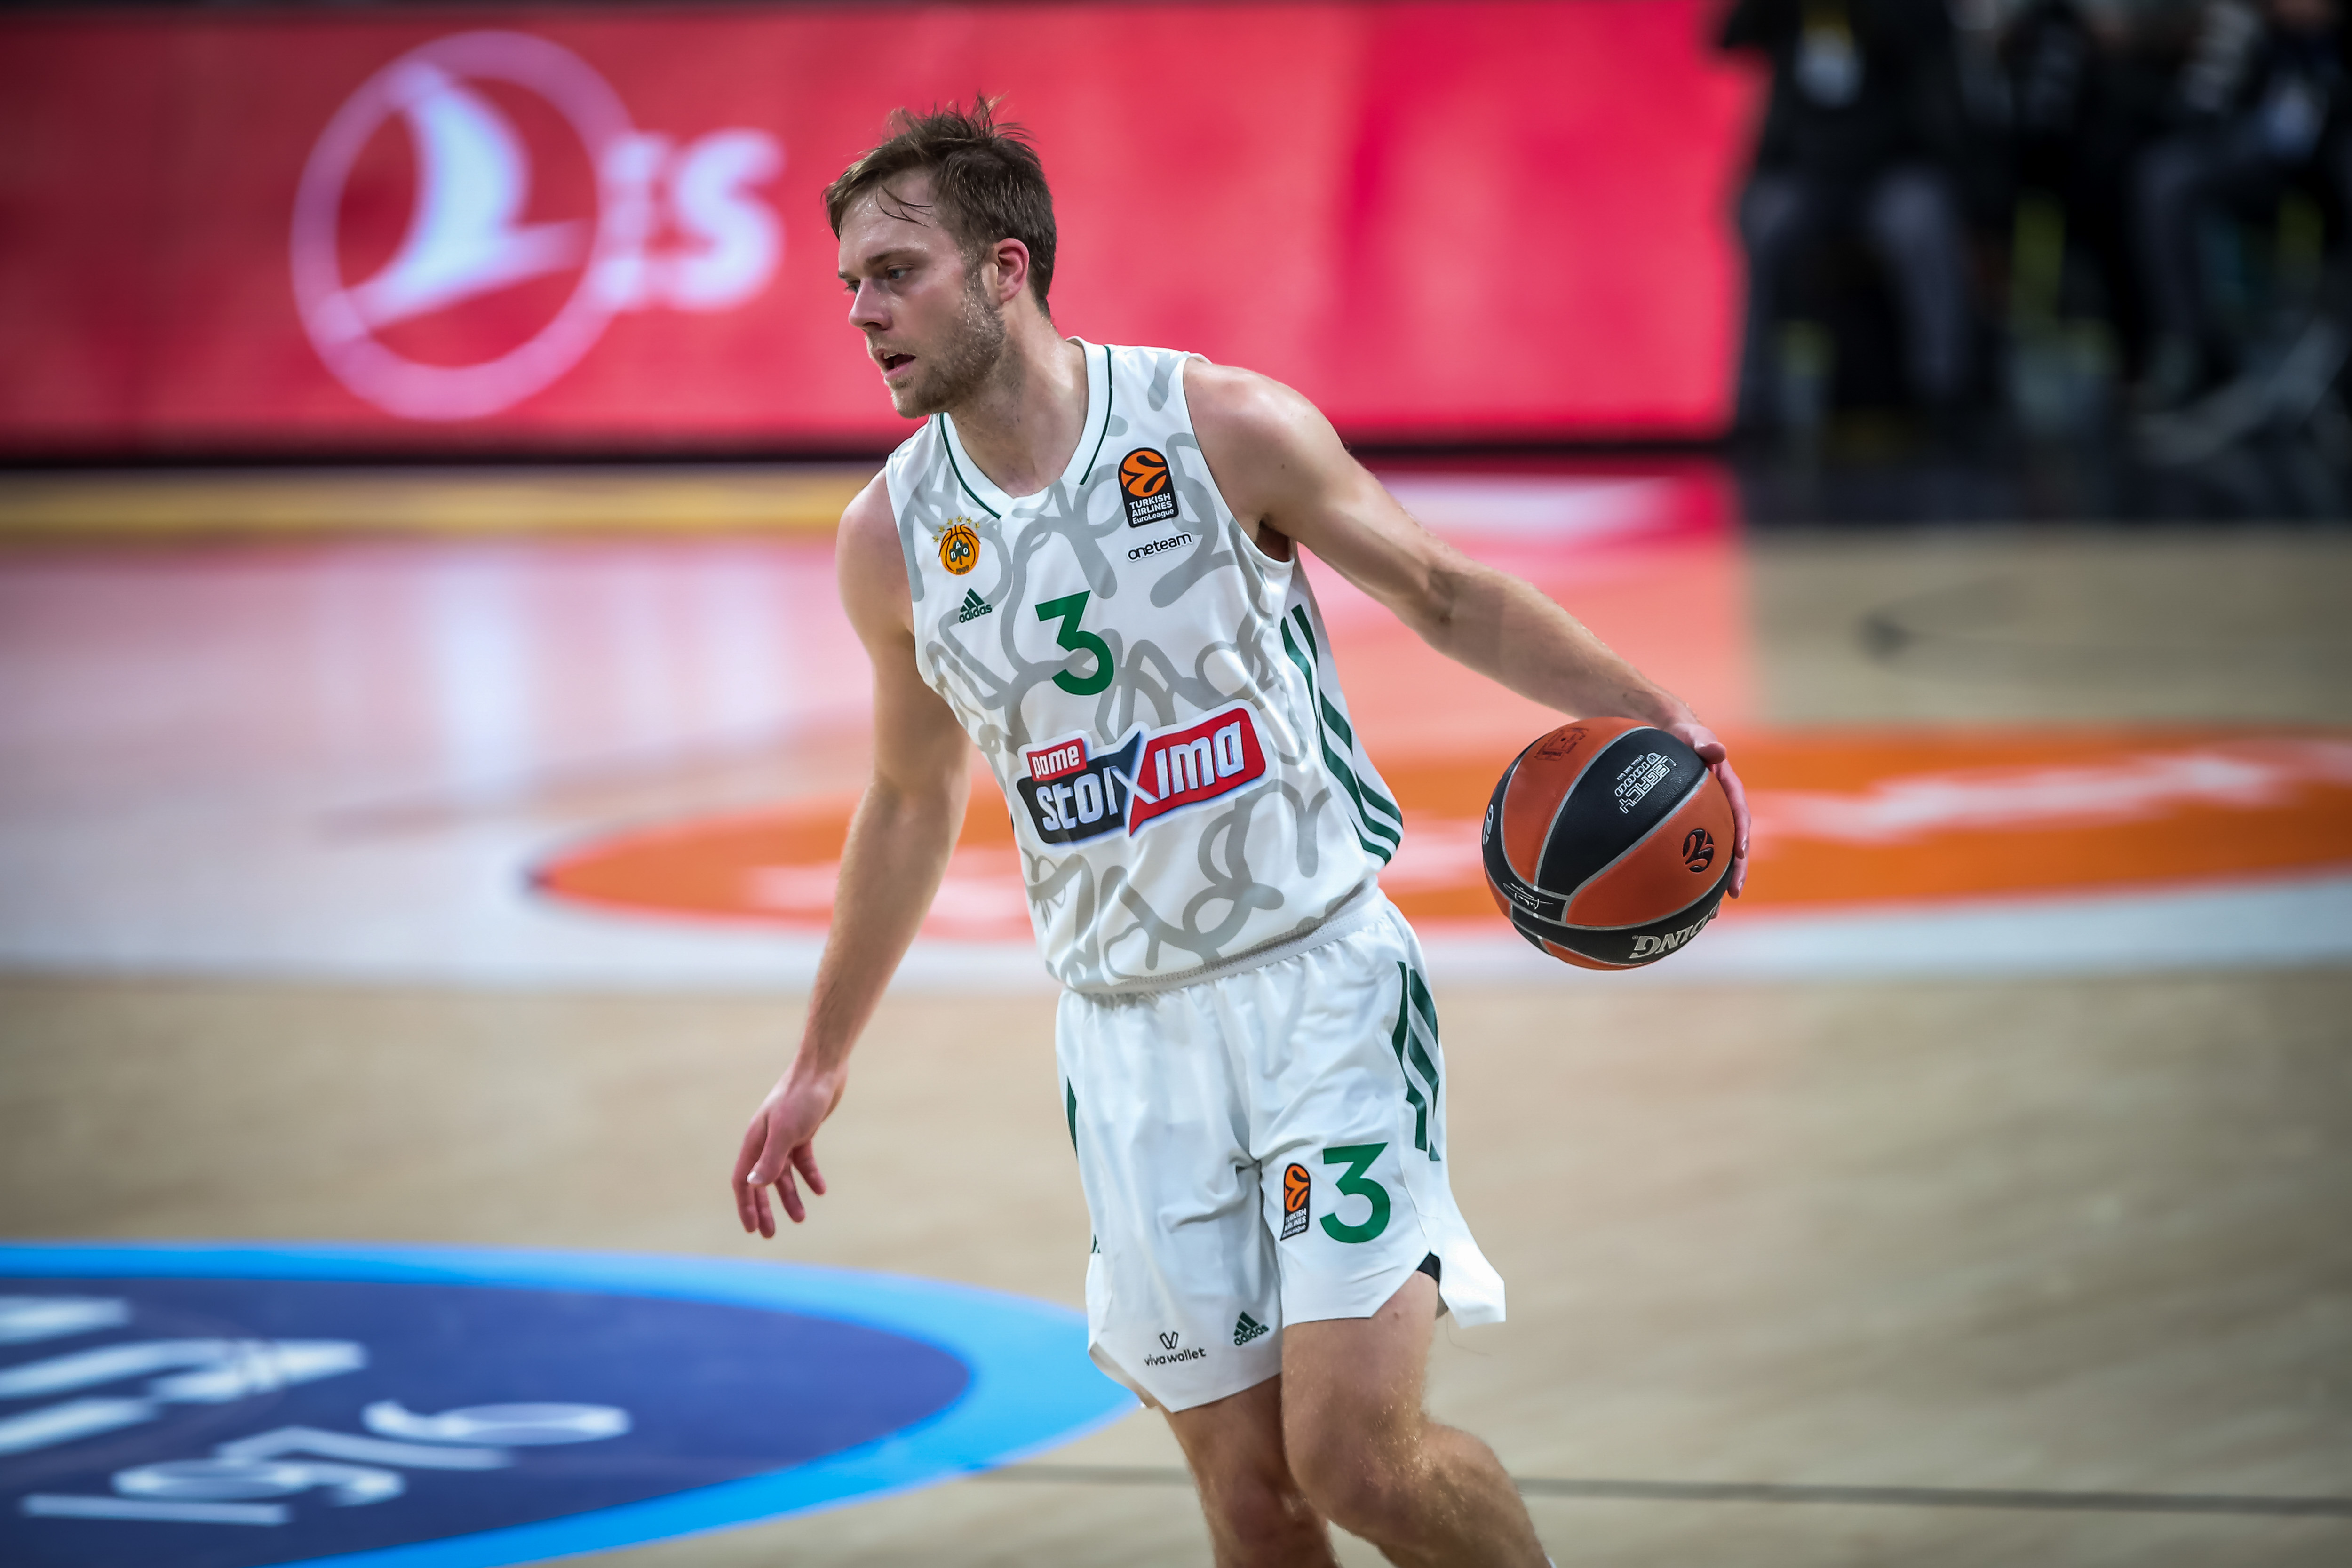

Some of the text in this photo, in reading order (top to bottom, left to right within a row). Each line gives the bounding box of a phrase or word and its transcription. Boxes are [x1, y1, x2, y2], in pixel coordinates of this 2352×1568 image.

[1129, 493, 1171, 509] TURKISH
[1132, 501, 1173, 517] AIRLINES
[1132, 509, 1174, 525] EuroLeague
[1128, 533, 1192, 560] oneteam
[959, 604, 992, 623] adidas
[1035, 590, 1114, 695] 3
[1032, 745, 1080, 779] pame
[1619, 755, 1677, 814] LEGACY
[1320, 1142, 1390, 1243] 3
[1233, 1324, 1269, 1346] adidas
